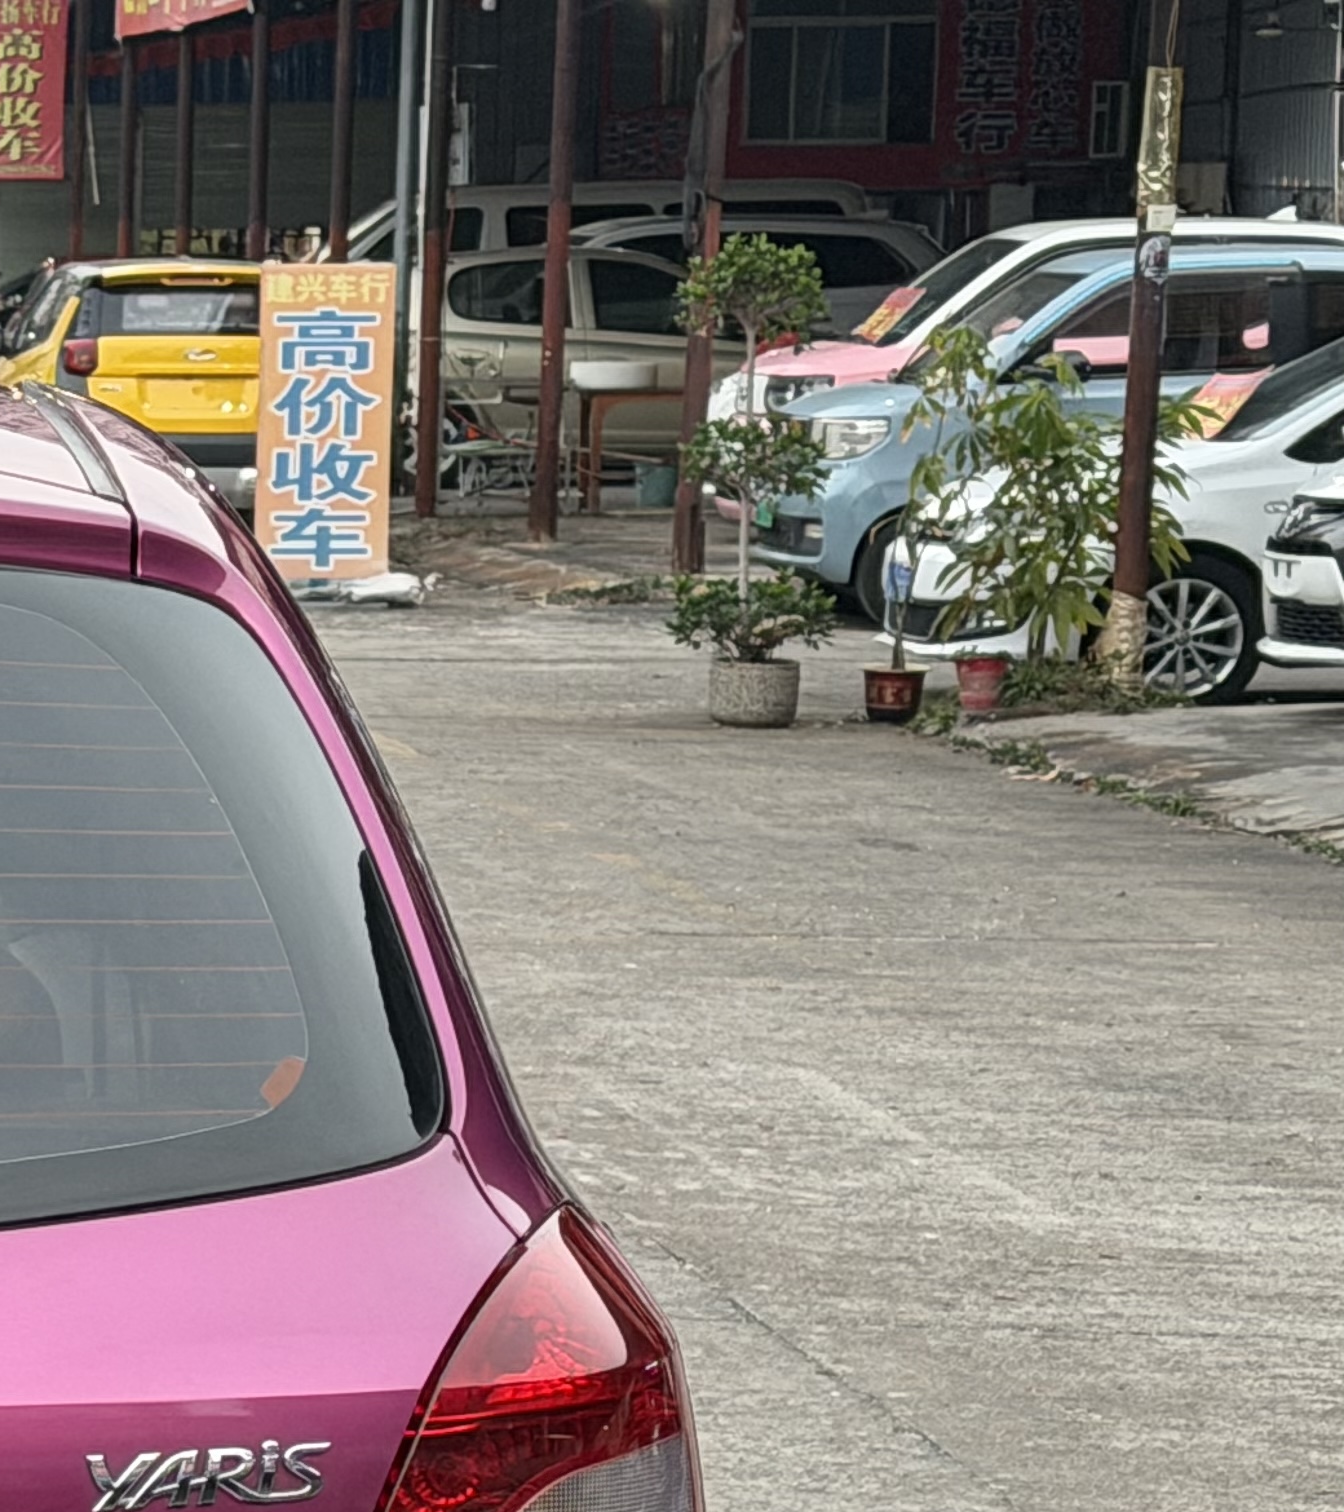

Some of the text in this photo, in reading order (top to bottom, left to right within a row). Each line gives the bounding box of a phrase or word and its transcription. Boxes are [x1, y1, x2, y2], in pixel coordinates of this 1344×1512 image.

[267, 272, 391, 304] 建兴车行
[271, 308, 380, 569] 高价收车
